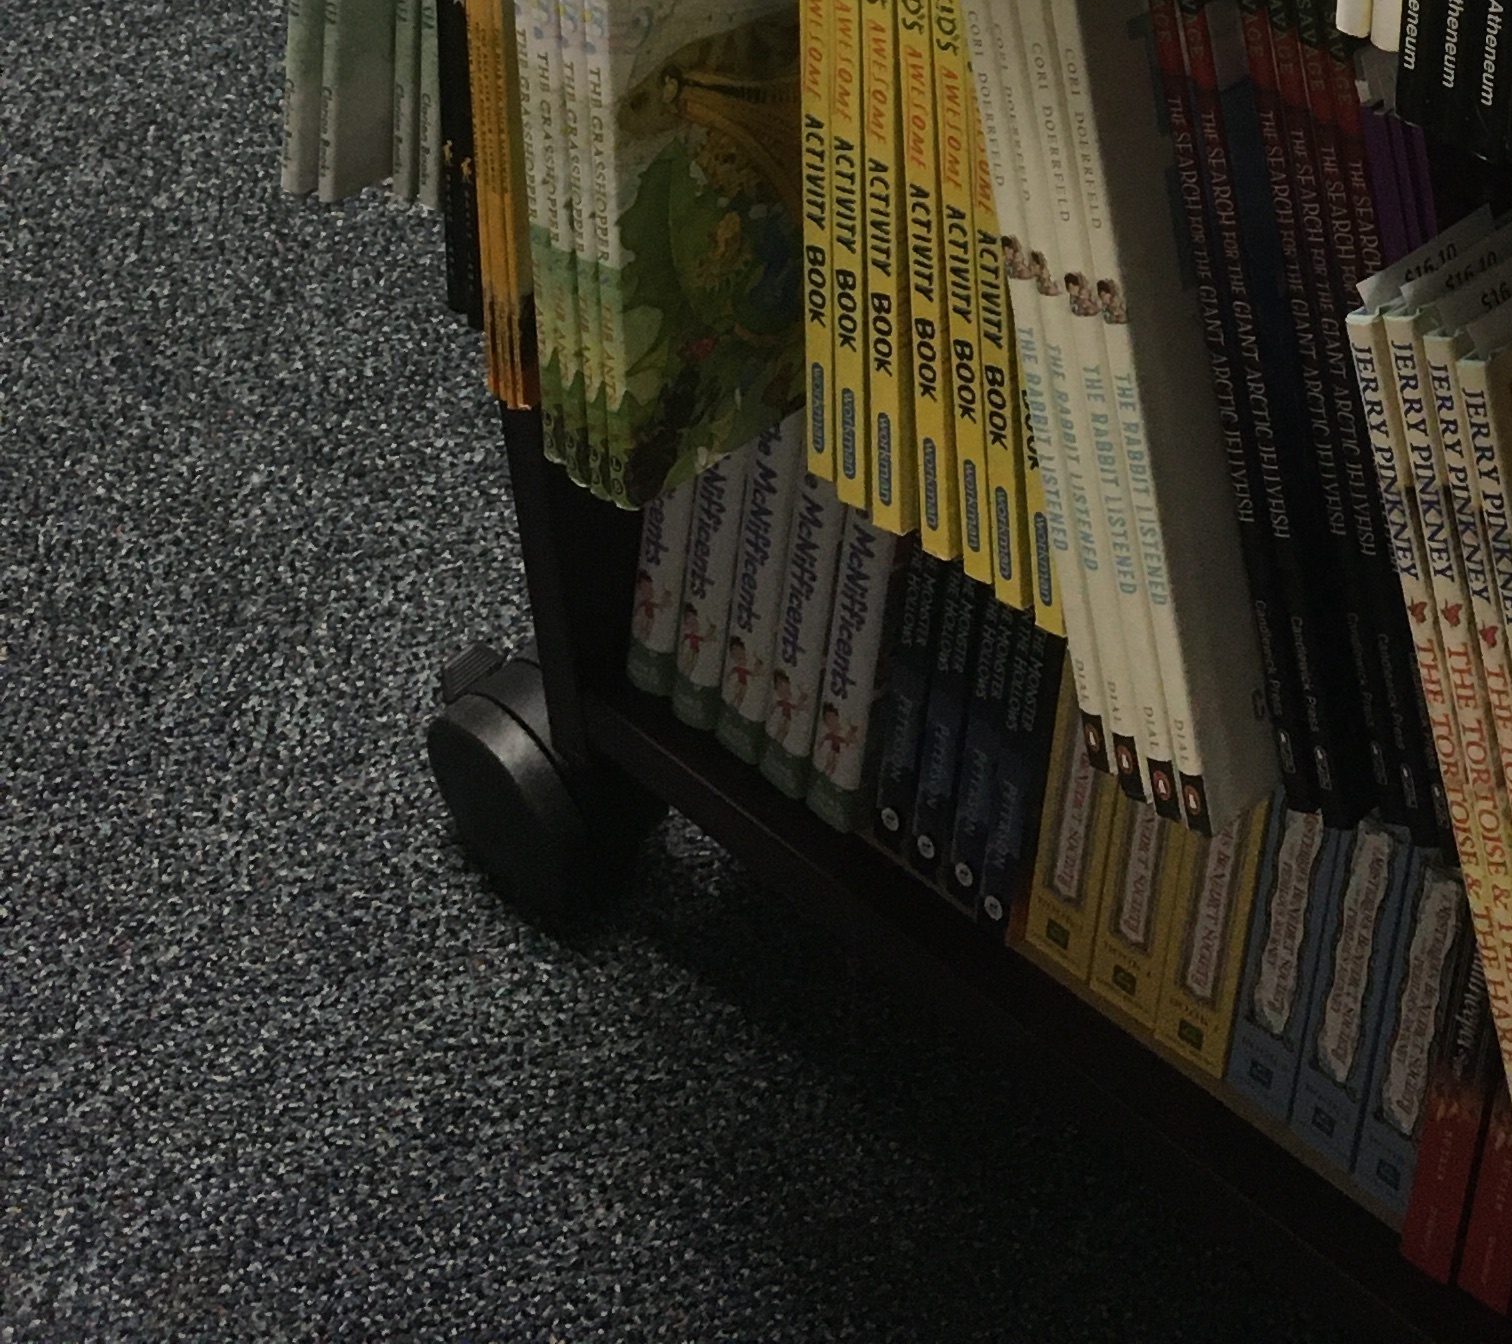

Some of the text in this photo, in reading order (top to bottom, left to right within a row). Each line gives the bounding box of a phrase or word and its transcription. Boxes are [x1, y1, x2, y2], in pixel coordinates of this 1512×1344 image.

[866, 18, 886, 144] AWESOME
[867, 158, 892, 376] ACTIVITY BOOK
[1208, 145, 1237, 226] SEARCH
[1232, 300, 1259, 362] GIANT
[1457, 387, 1494, 480] JERRY
